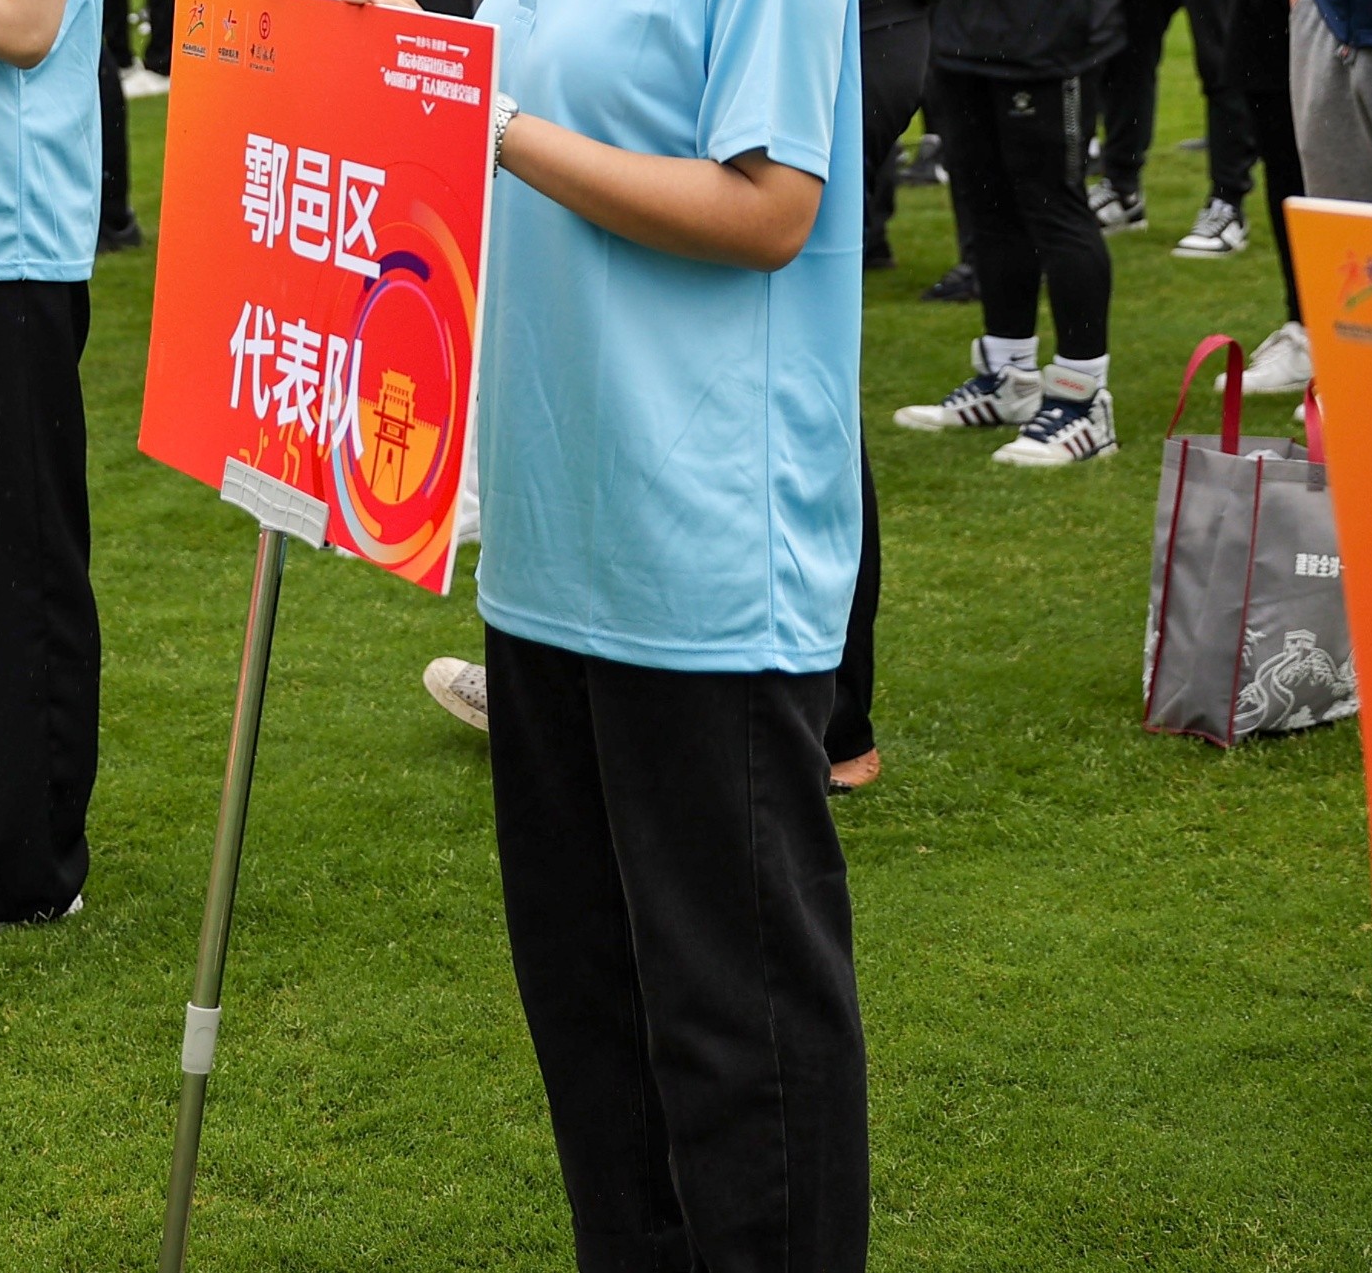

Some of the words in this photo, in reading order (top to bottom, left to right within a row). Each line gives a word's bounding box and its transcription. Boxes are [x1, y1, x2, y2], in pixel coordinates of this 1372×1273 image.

[240, 133, 386, 280] 鄠邑区
[224, 300, 366, 460] 代表队
